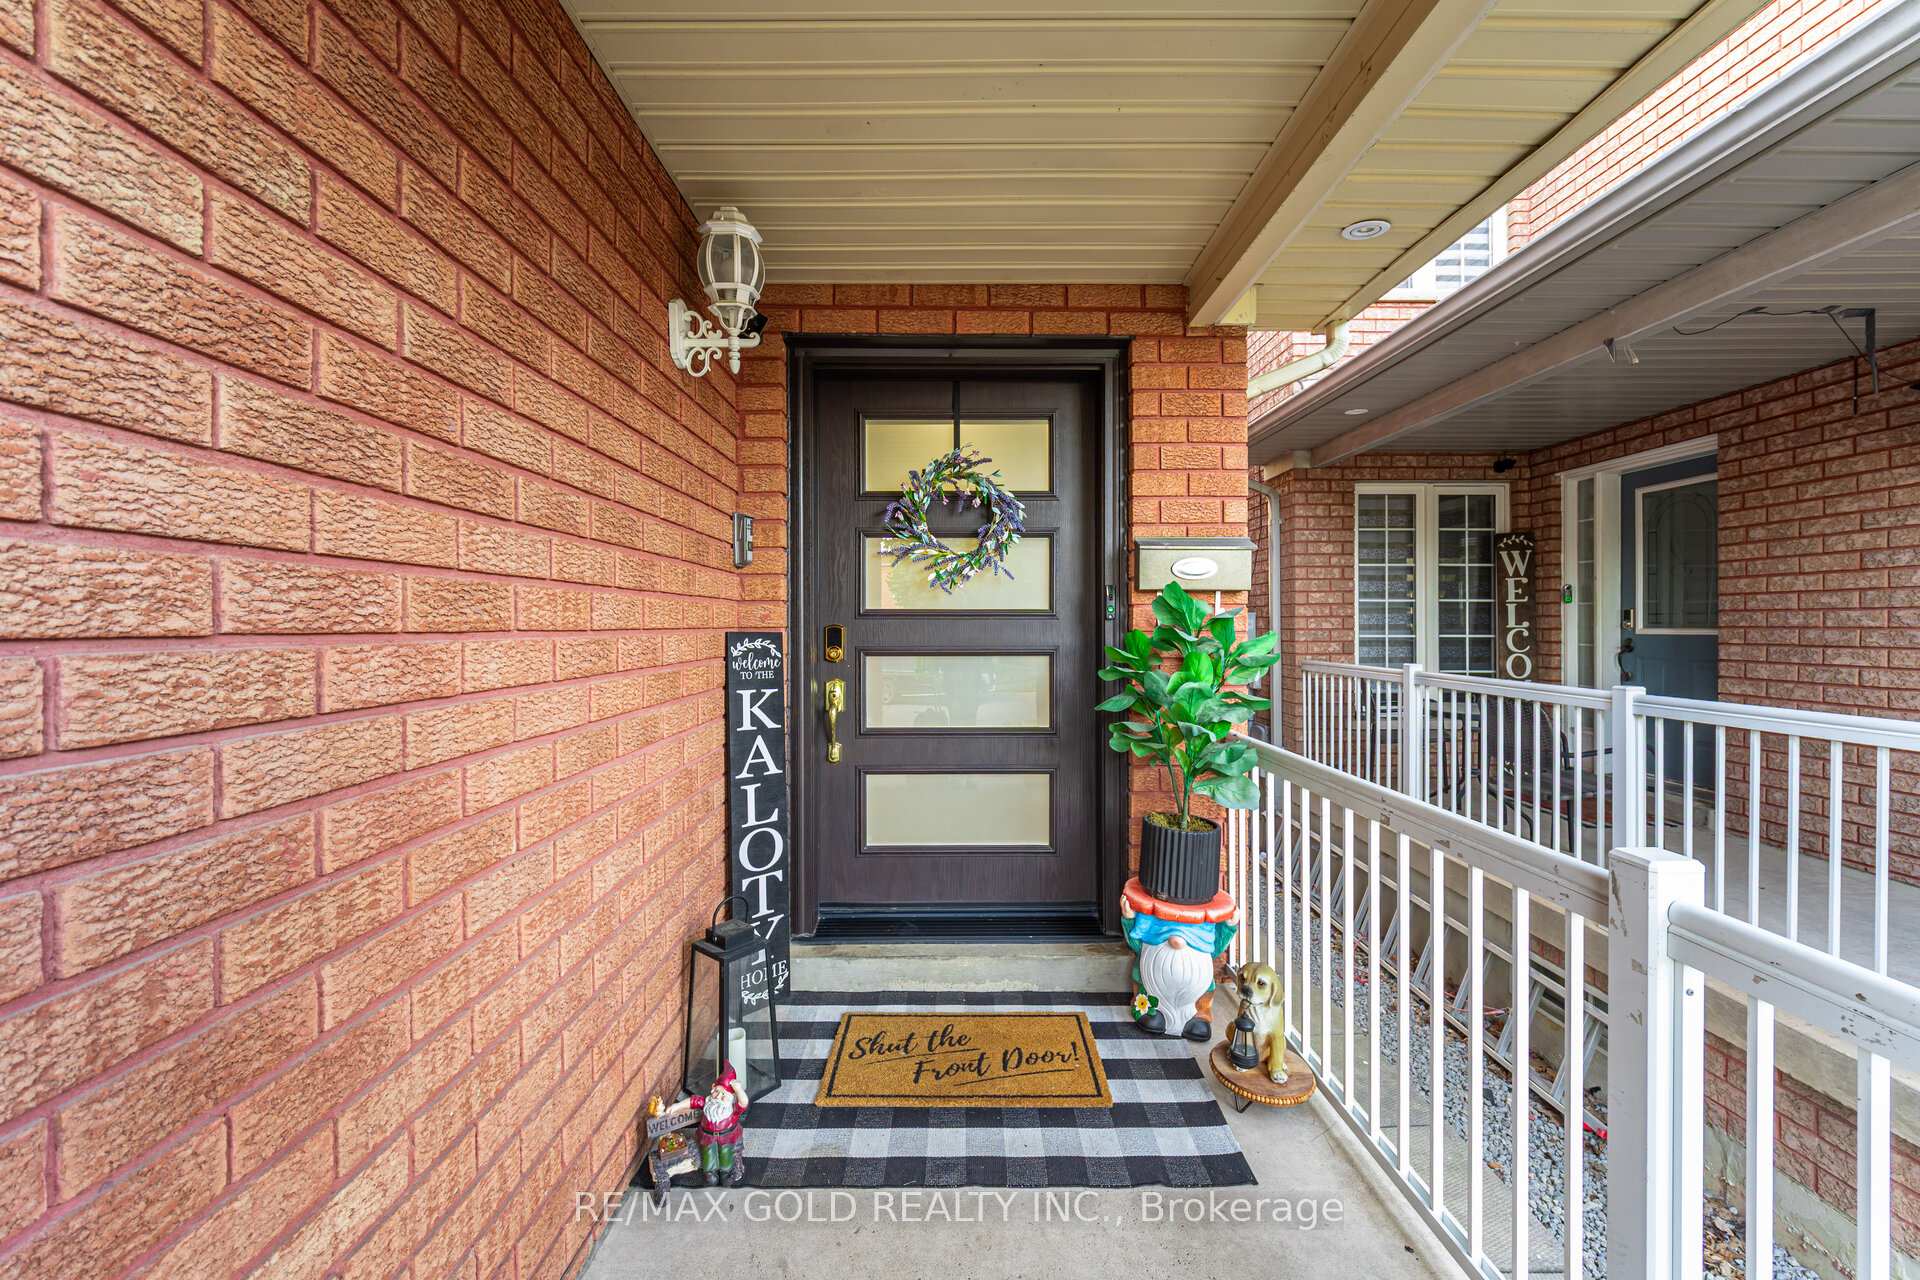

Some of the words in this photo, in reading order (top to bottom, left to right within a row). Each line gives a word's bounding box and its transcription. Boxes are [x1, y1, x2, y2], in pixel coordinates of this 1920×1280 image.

[1499, 550, 1532, 682] WELCO
[732, 652, 781, 671] welcome
[740, 671, 753, 680] TO
[755, 670, 775, 680] THE
[848, 1031, 916, 1060] Shut
[920, 1023, 972, 1052] the
[911, 1051, 991, 1084] Front
[1001, 1041, 1079, 1072] Door!
[648, 1108, 700, 1134] WELCOME
